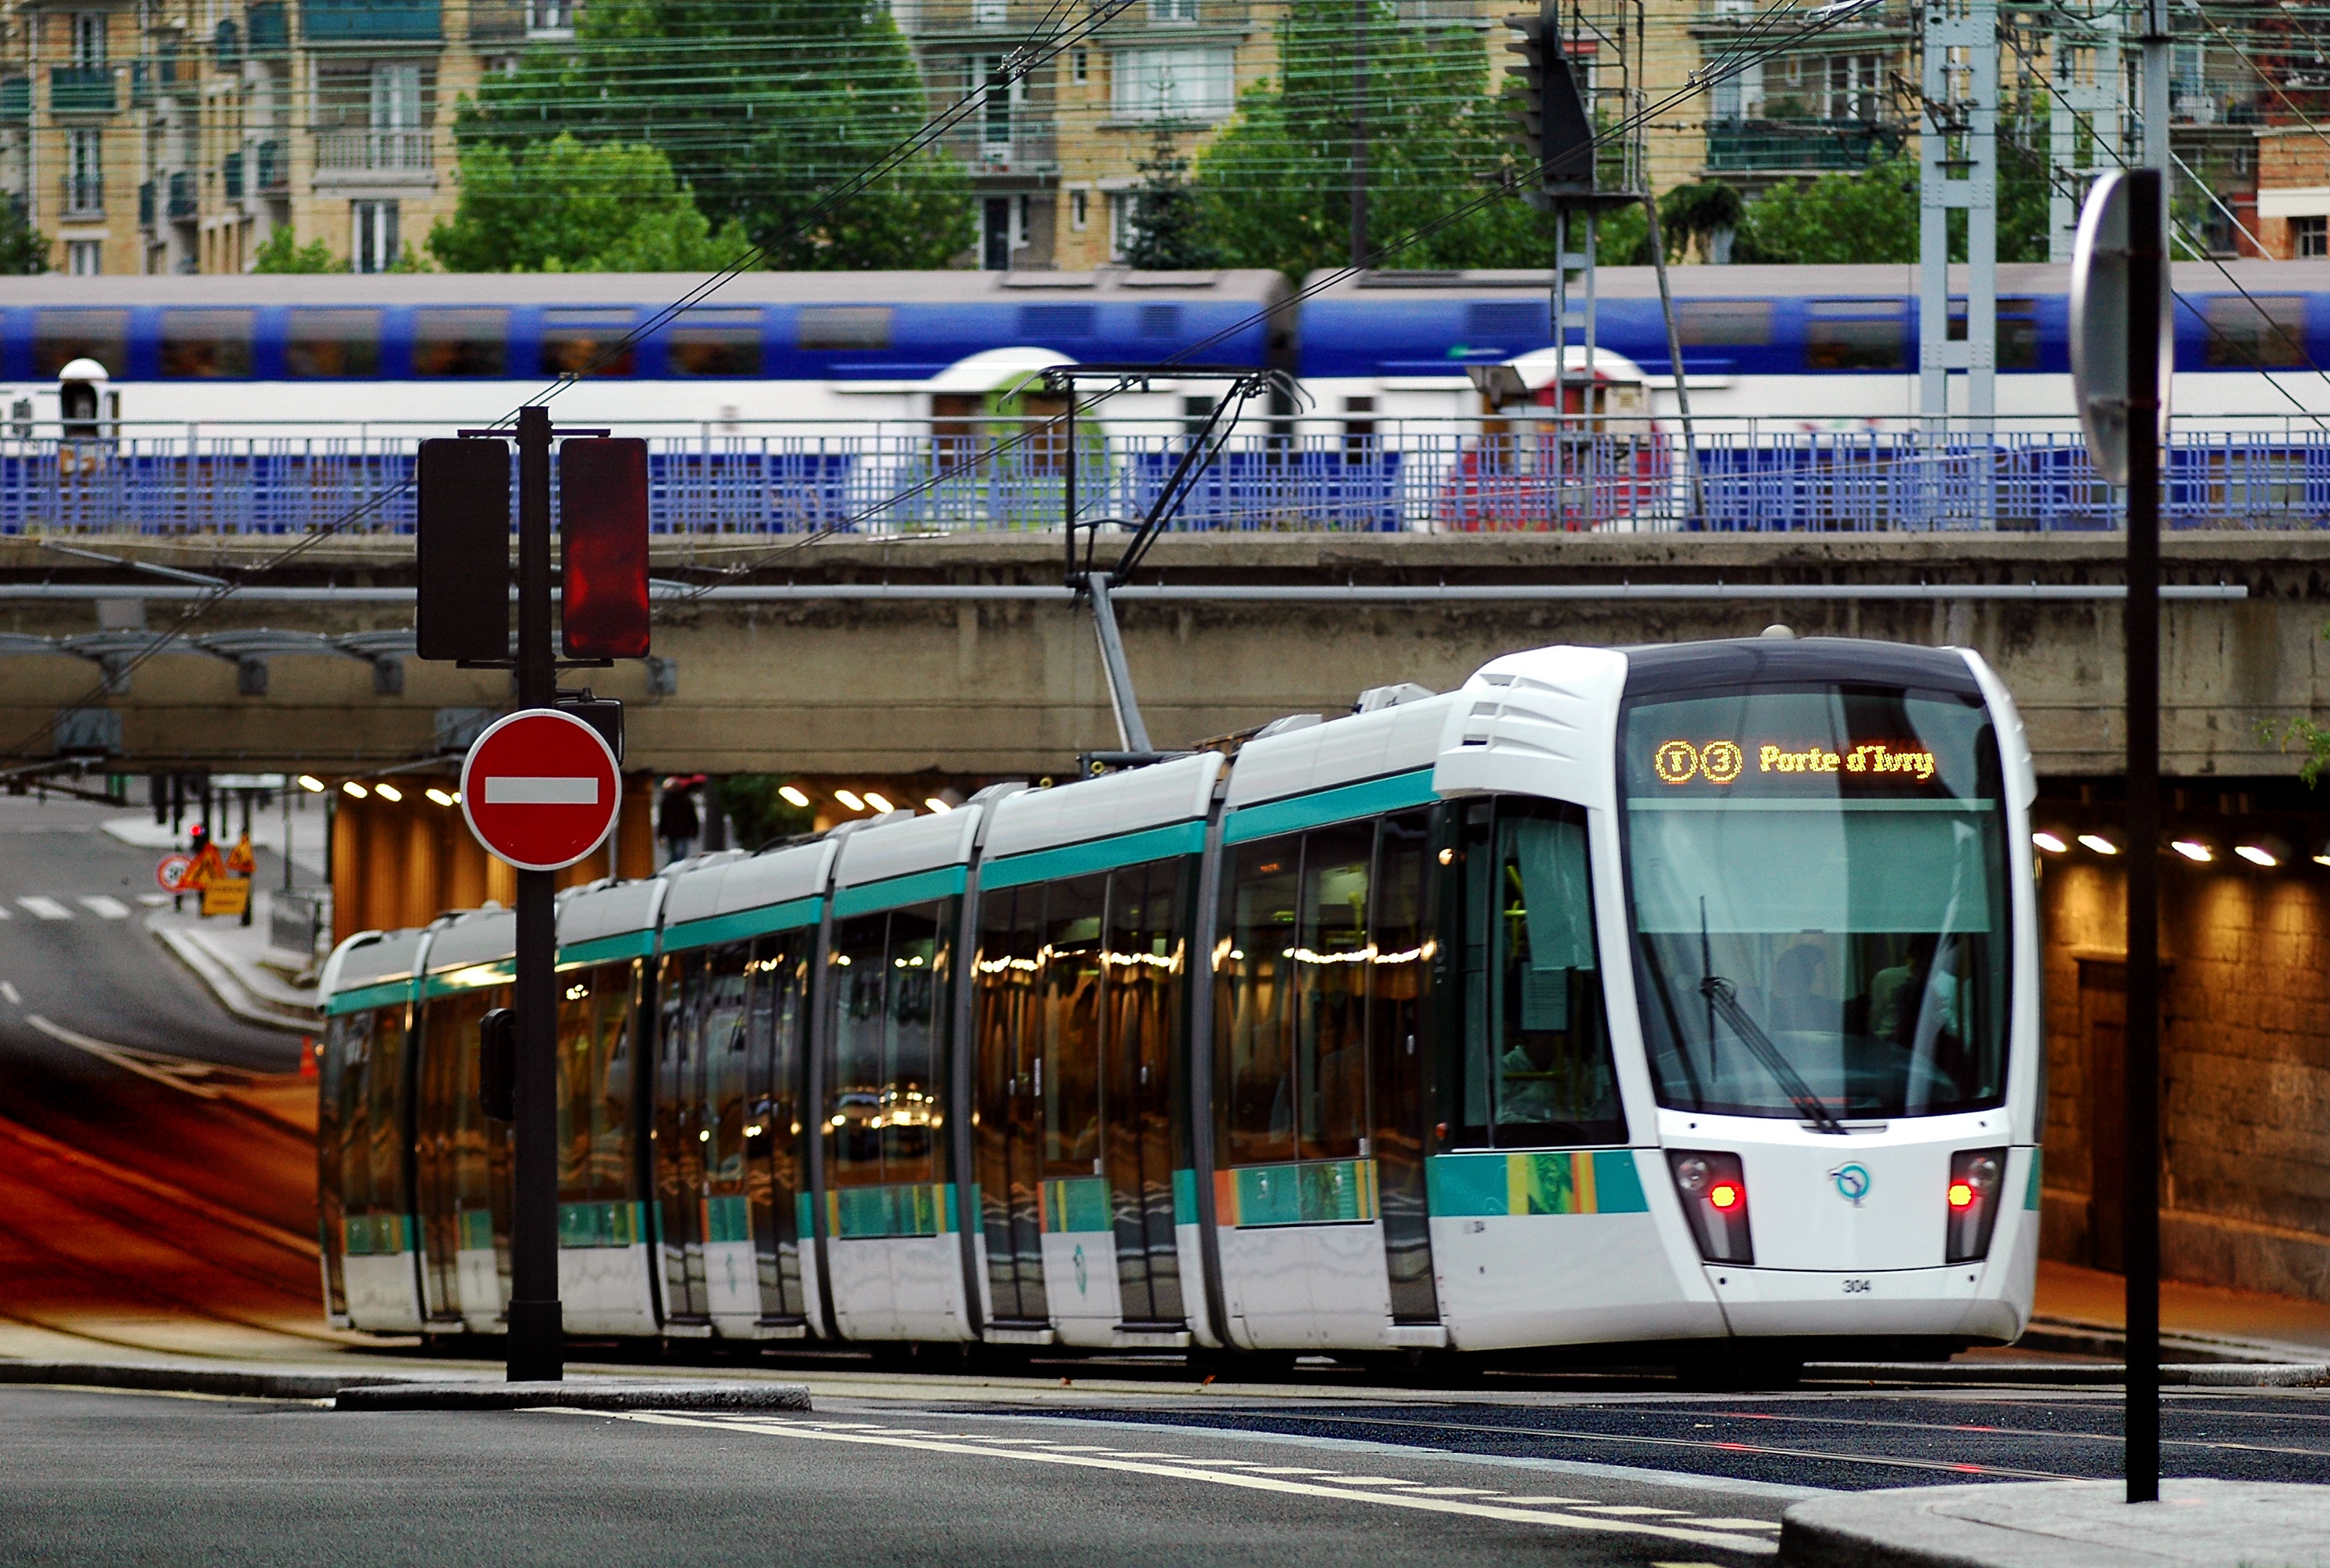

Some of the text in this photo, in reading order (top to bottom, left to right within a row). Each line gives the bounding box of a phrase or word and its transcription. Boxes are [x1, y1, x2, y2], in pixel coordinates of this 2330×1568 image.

[1759, 745, 1841, 772] Porte
[1846, 745, 1935, 779] d'Ivry
[1842, 1279, 1871, 1293] 304
